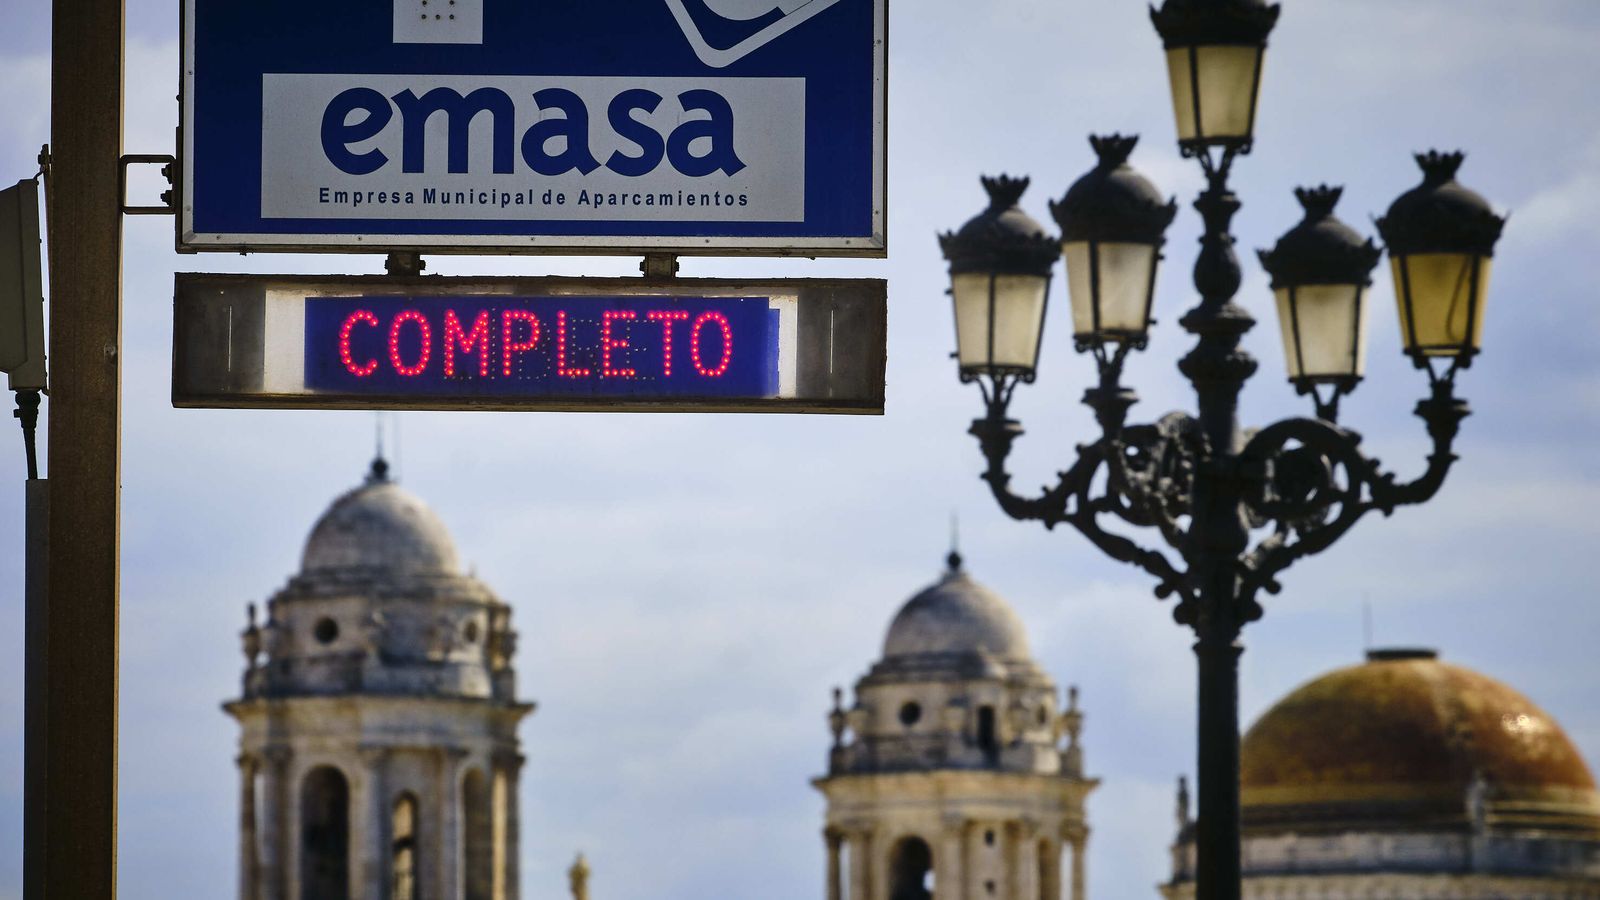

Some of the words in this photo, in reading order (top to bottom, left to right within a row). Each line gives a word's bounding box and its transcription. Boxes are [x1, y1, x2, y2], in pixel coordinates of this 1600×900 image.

[320, 86, 747, 178] emasa
[319, 187, 413, 207] Empresa
[422, 187, 533, 208] Municipal
[541, 188, 566, 205] de
[577, 188, 749, 208] Aparcamientos
[338, 308, 734, 379] COMPLETO
